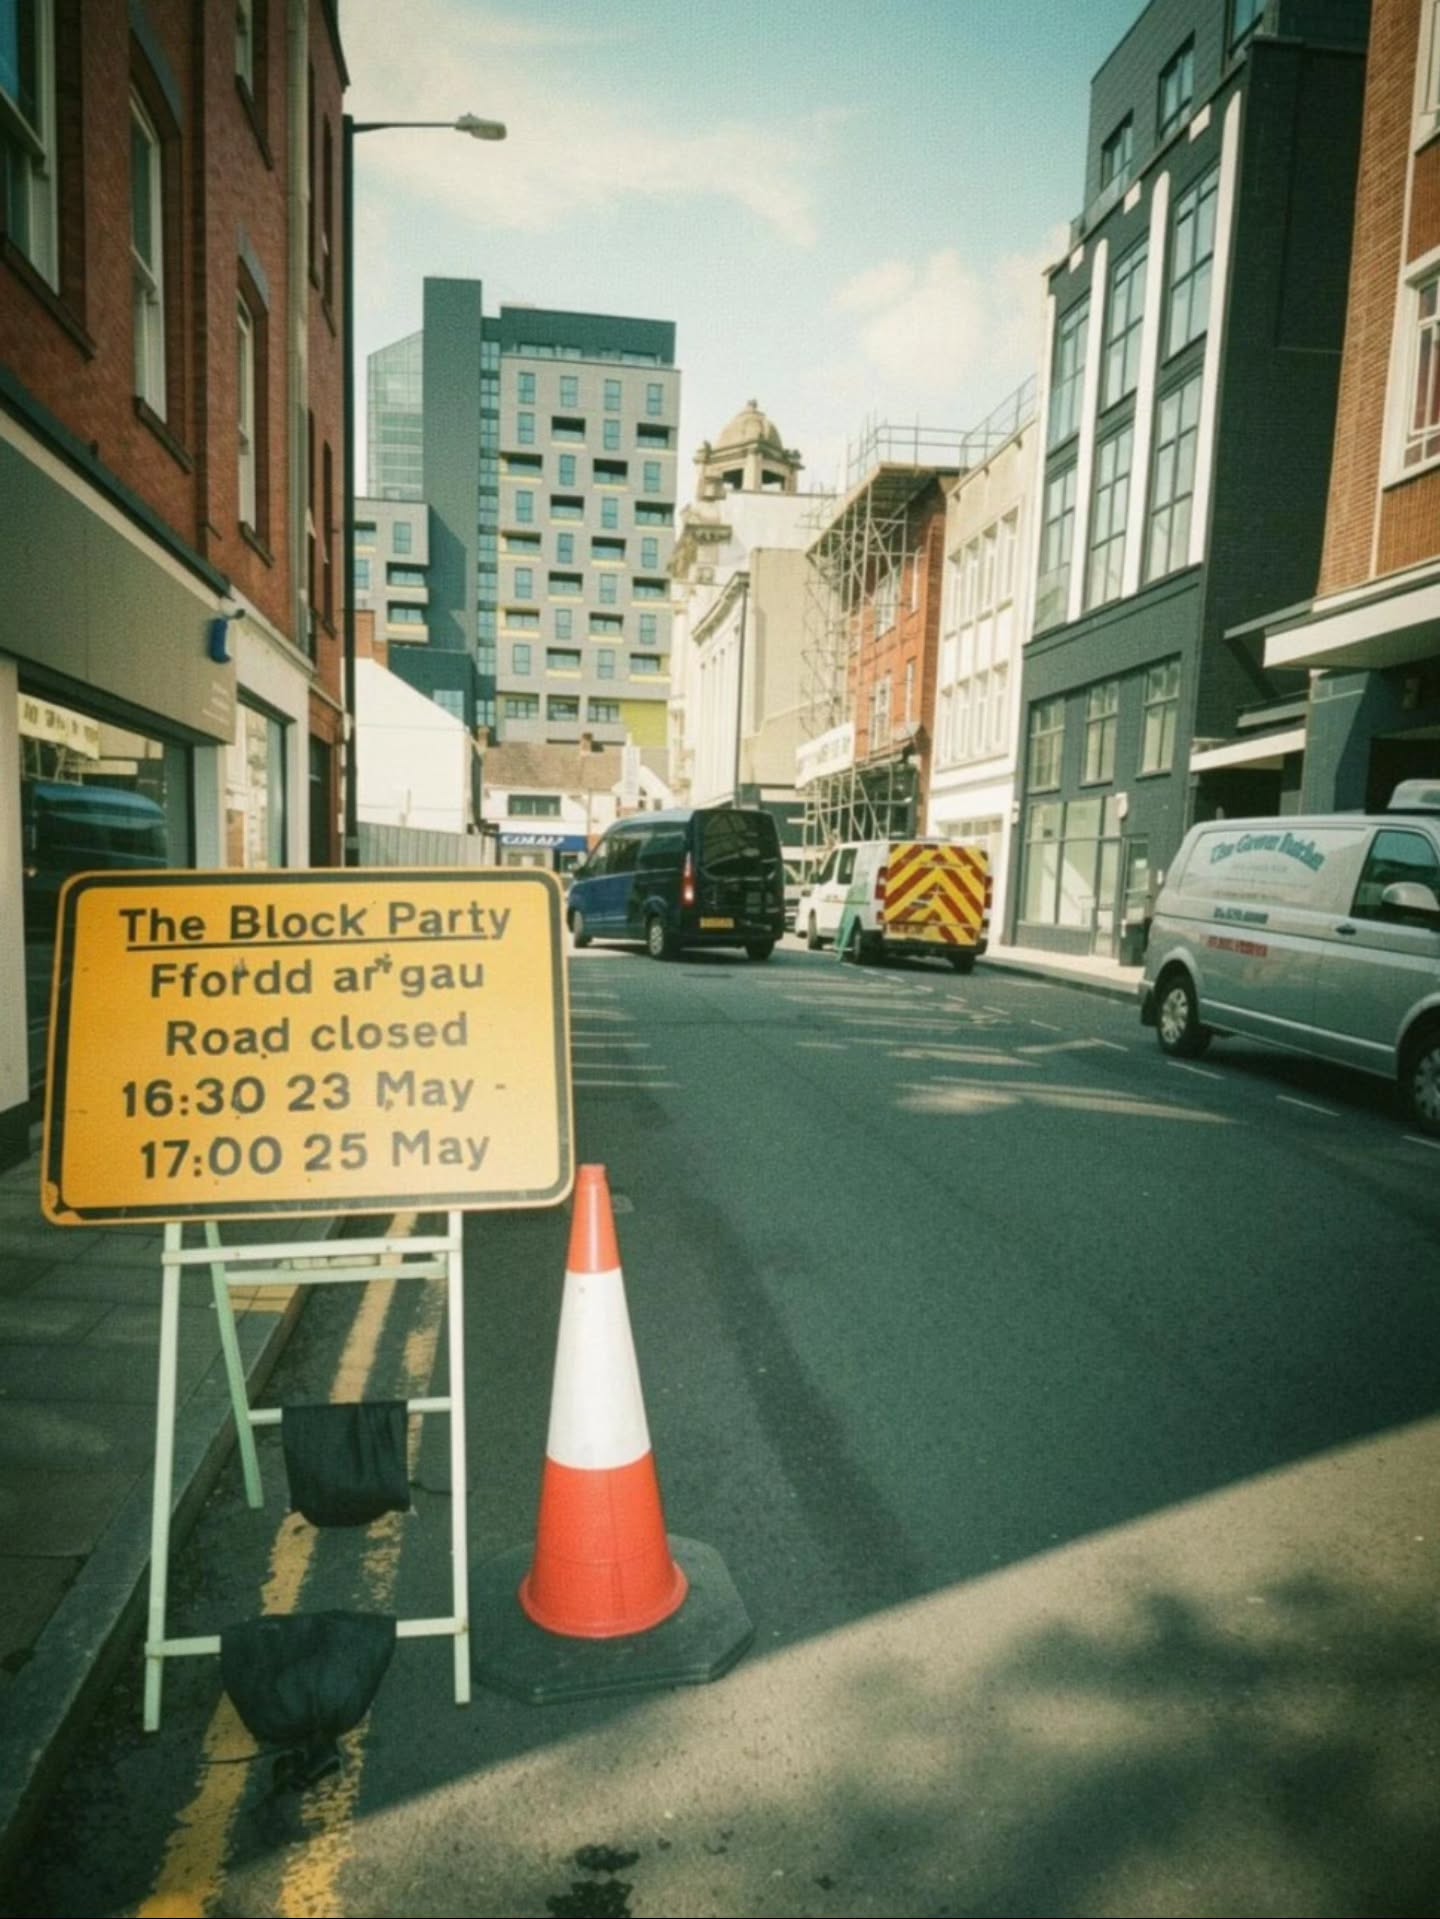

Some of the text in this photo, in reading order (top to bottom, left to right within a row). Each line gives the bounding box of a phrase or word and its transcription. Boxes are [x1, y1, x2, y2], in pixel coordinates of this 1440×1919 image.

[120, 901, 511, 943] The Block Party
[152, 959, 484, 998] Ffordd ar gau
[166, 1011, 468, 1056] Road closed
[122, 1076, 265, 1117] 16:30
[288, 1072, 351, 1111] 23
[377, 1070, 474, 1112] May
[140, 1130, 491, 1178] 17:00 25 May
